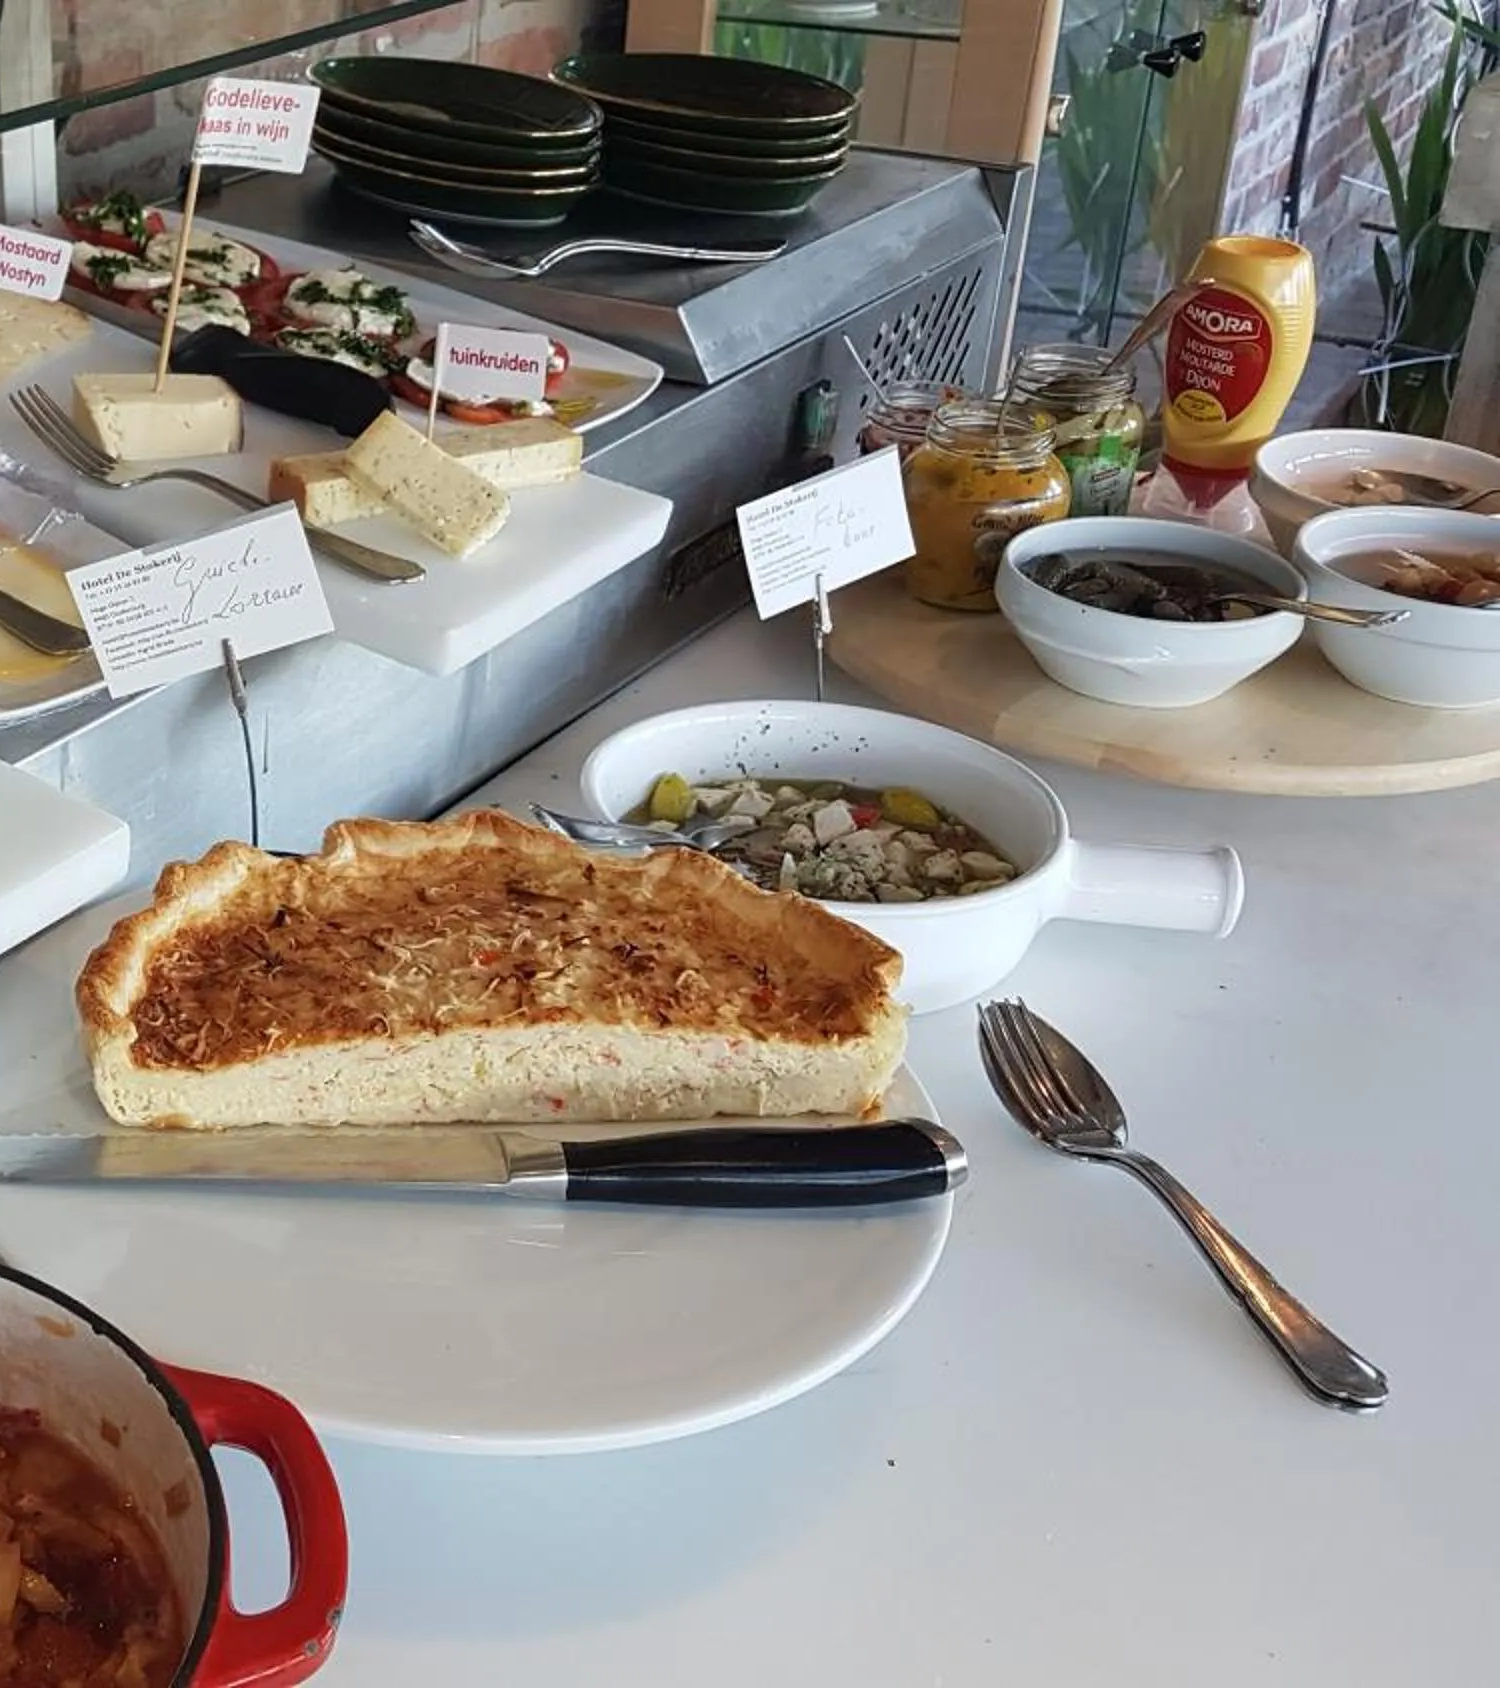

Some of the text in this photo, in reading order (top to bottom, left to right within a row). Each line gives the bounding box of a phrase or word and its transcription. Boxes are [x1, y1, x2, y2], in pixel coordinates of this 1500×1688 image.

[237, 116, 251, 136] in
[256, 119, 289, 142] wijn
[1185, 303, 1254, 334] AMORA
[449, 346, 540, 374] tuinkruiden
[1180, 348, 1237, 377] MOUTARDE
[1185, 337, 1234, 362] MOSTERD
[81, 572, 114, 591] Hotel
